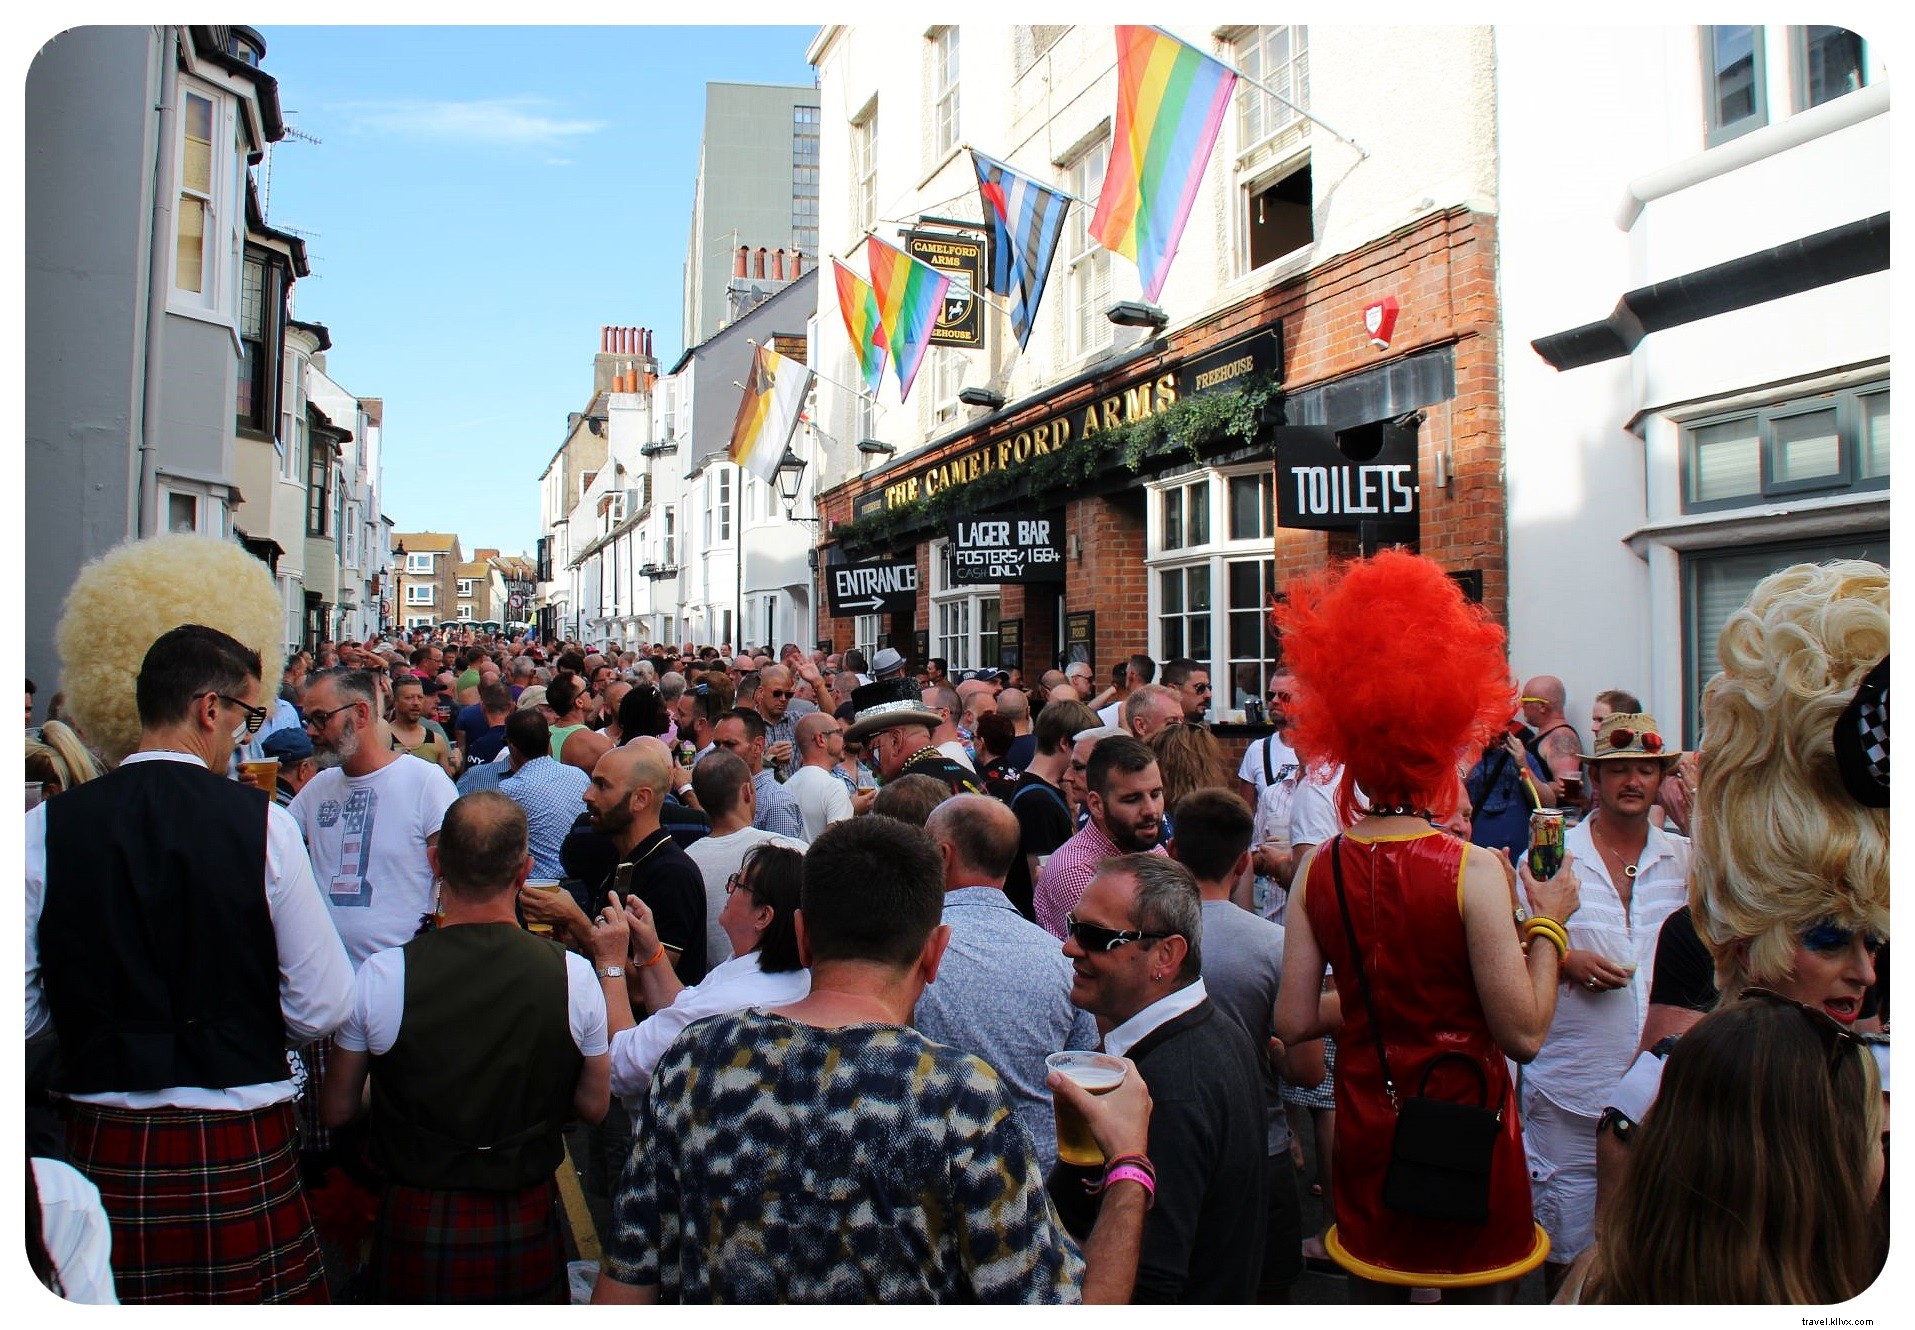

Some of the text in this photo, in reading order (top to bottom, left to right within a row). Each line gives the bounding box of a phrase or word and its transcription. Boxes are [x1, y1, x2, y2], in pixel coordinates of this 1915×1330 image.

[914, 242, 977, 257] CAMELFORD
[931, 255, 960, 266] ARMS
[1196, 355, 1254, 390] FREEHOUSE
[885, 372, 1180, 510] THE CAMELFORD ARMS
[1291, 464, 1413, 515] TOILETS
[958, 520, 1050, 547] LAGER BAR
[836, 564, 917, 597] ENTRANCE
[989, 564, 1024, 577] ONLY
